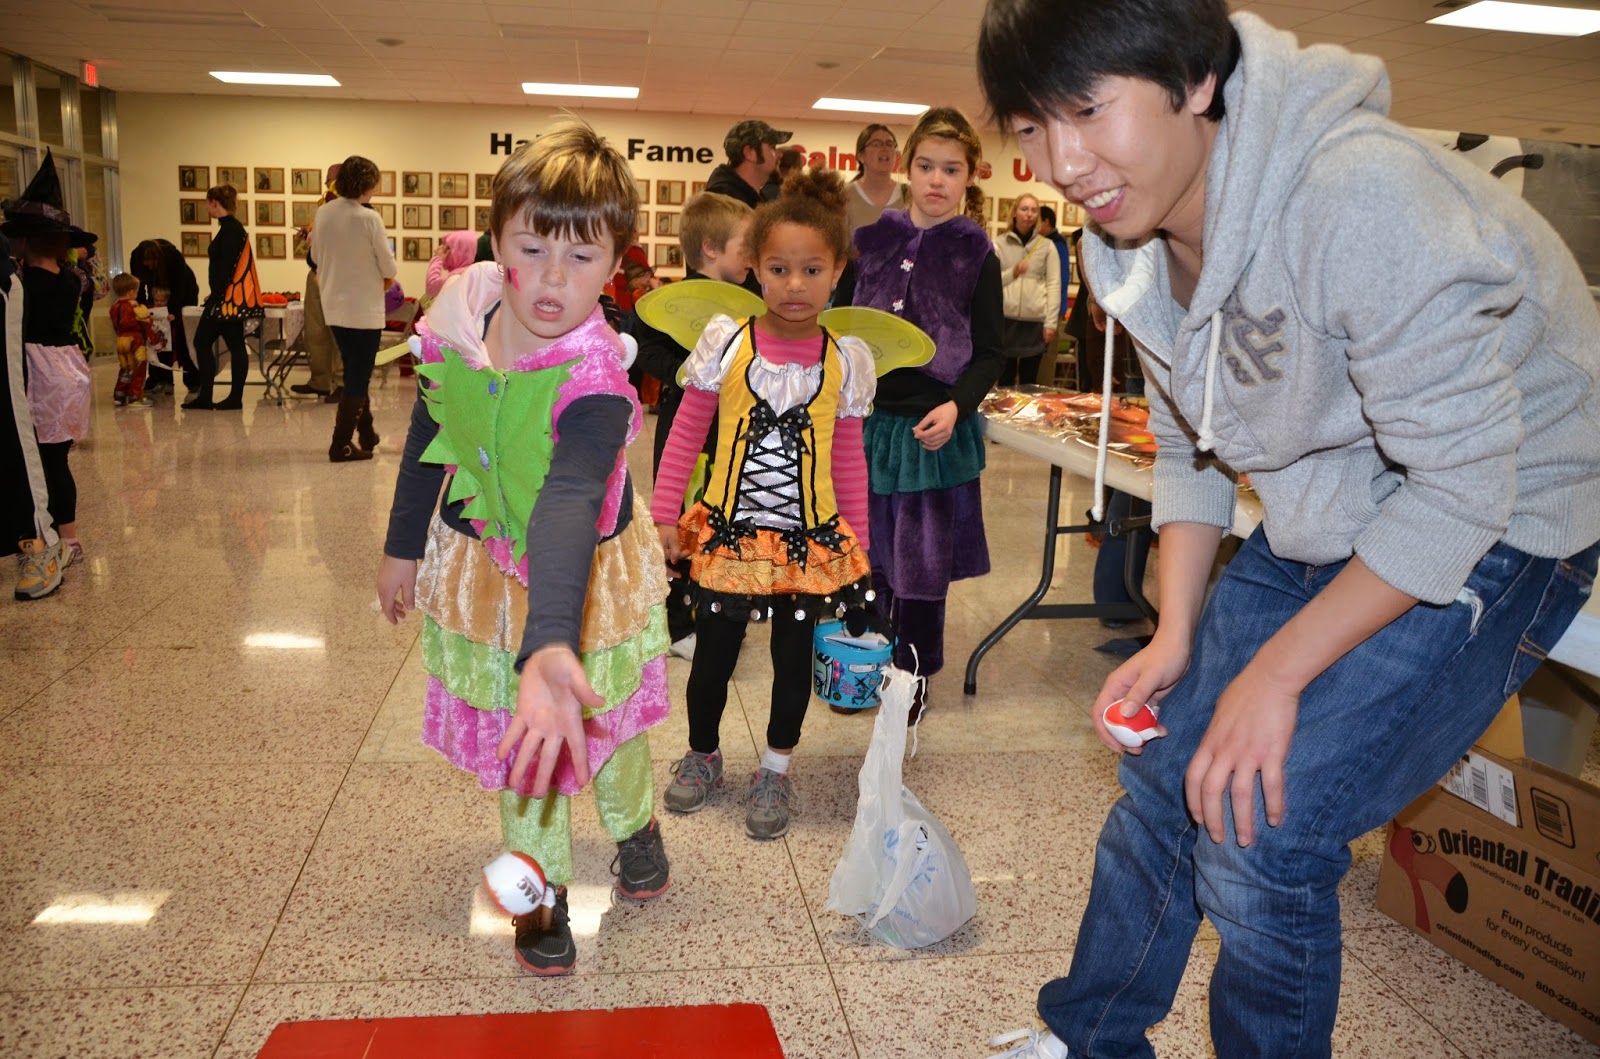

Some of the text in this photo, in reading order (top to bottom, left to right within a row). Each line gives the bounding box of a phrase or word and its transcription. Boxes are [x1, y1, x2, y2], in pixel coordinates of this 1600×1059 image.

[627, 138, 714, 163] Fame
[1438, 828, 1600, 925] Oriental Tradi
[1470, 860, 1585, 924] celebrating over 80 years of fun
[1436, 923, 1525, 980] orientaltrading.com
[1486, 917, 1586, 983] for every occasion!
[1501, 909, 1573, 957] Fun products
